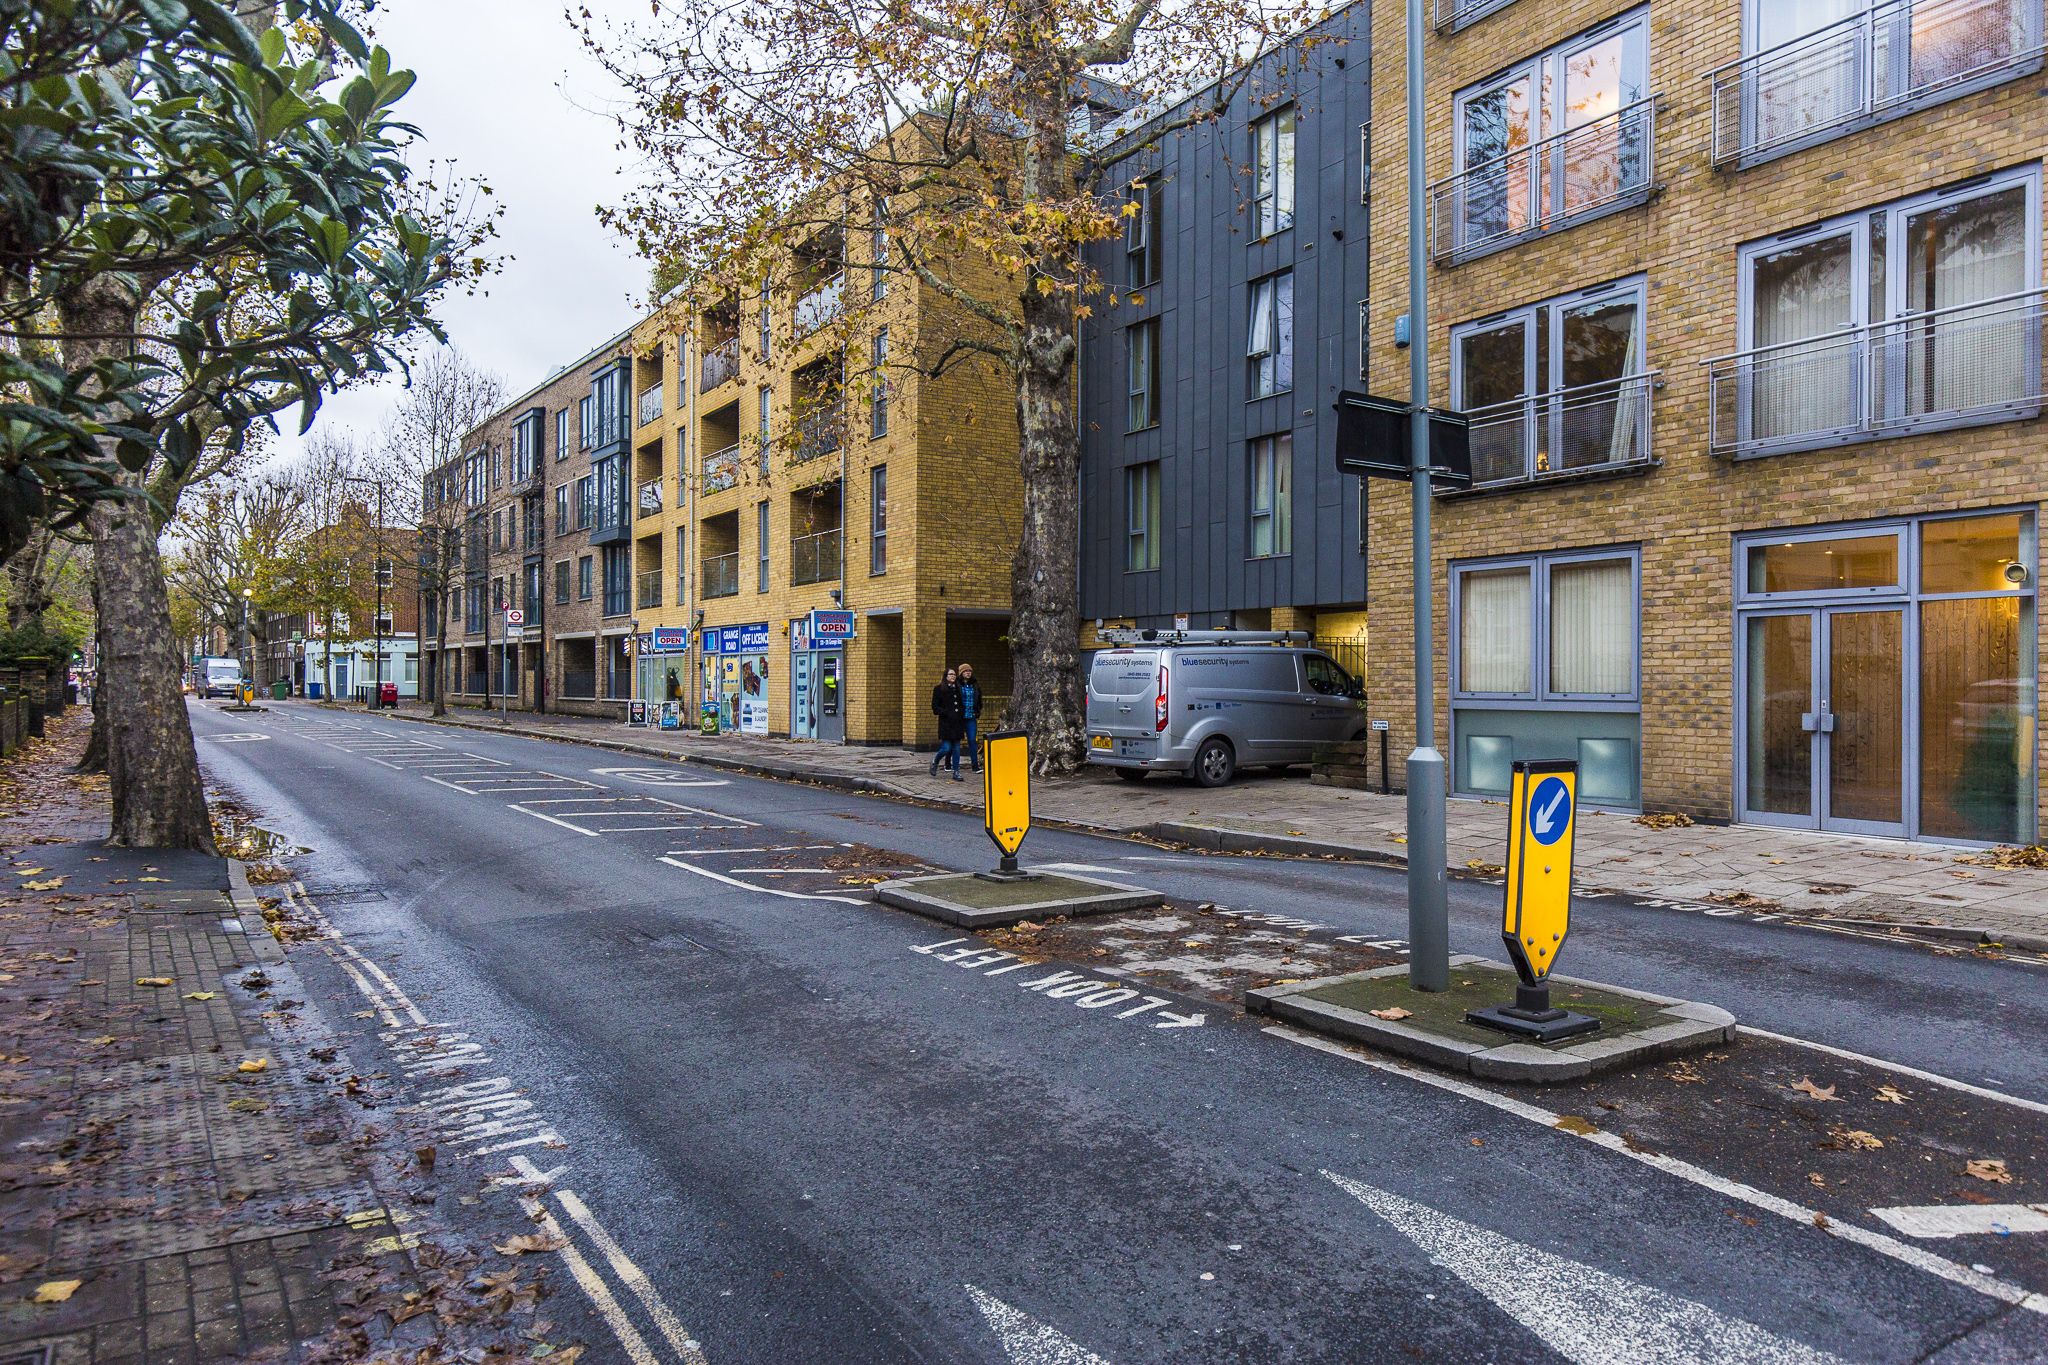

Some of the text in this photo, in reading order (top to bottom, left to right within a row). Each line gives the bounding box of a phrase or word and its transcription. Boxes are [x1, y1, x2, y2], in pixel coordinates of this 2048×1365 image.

[821, 624, 846, 632] OPEN
[723, 630, 739, 640] GRANGE
[742, 632, 768, 645] OFF LICENC
[725, 641, 736, 651] ROAD
[907, 937, 1173, 1020] LOOK LEFT
[417, 1077, 568, 1160] RIGHT
